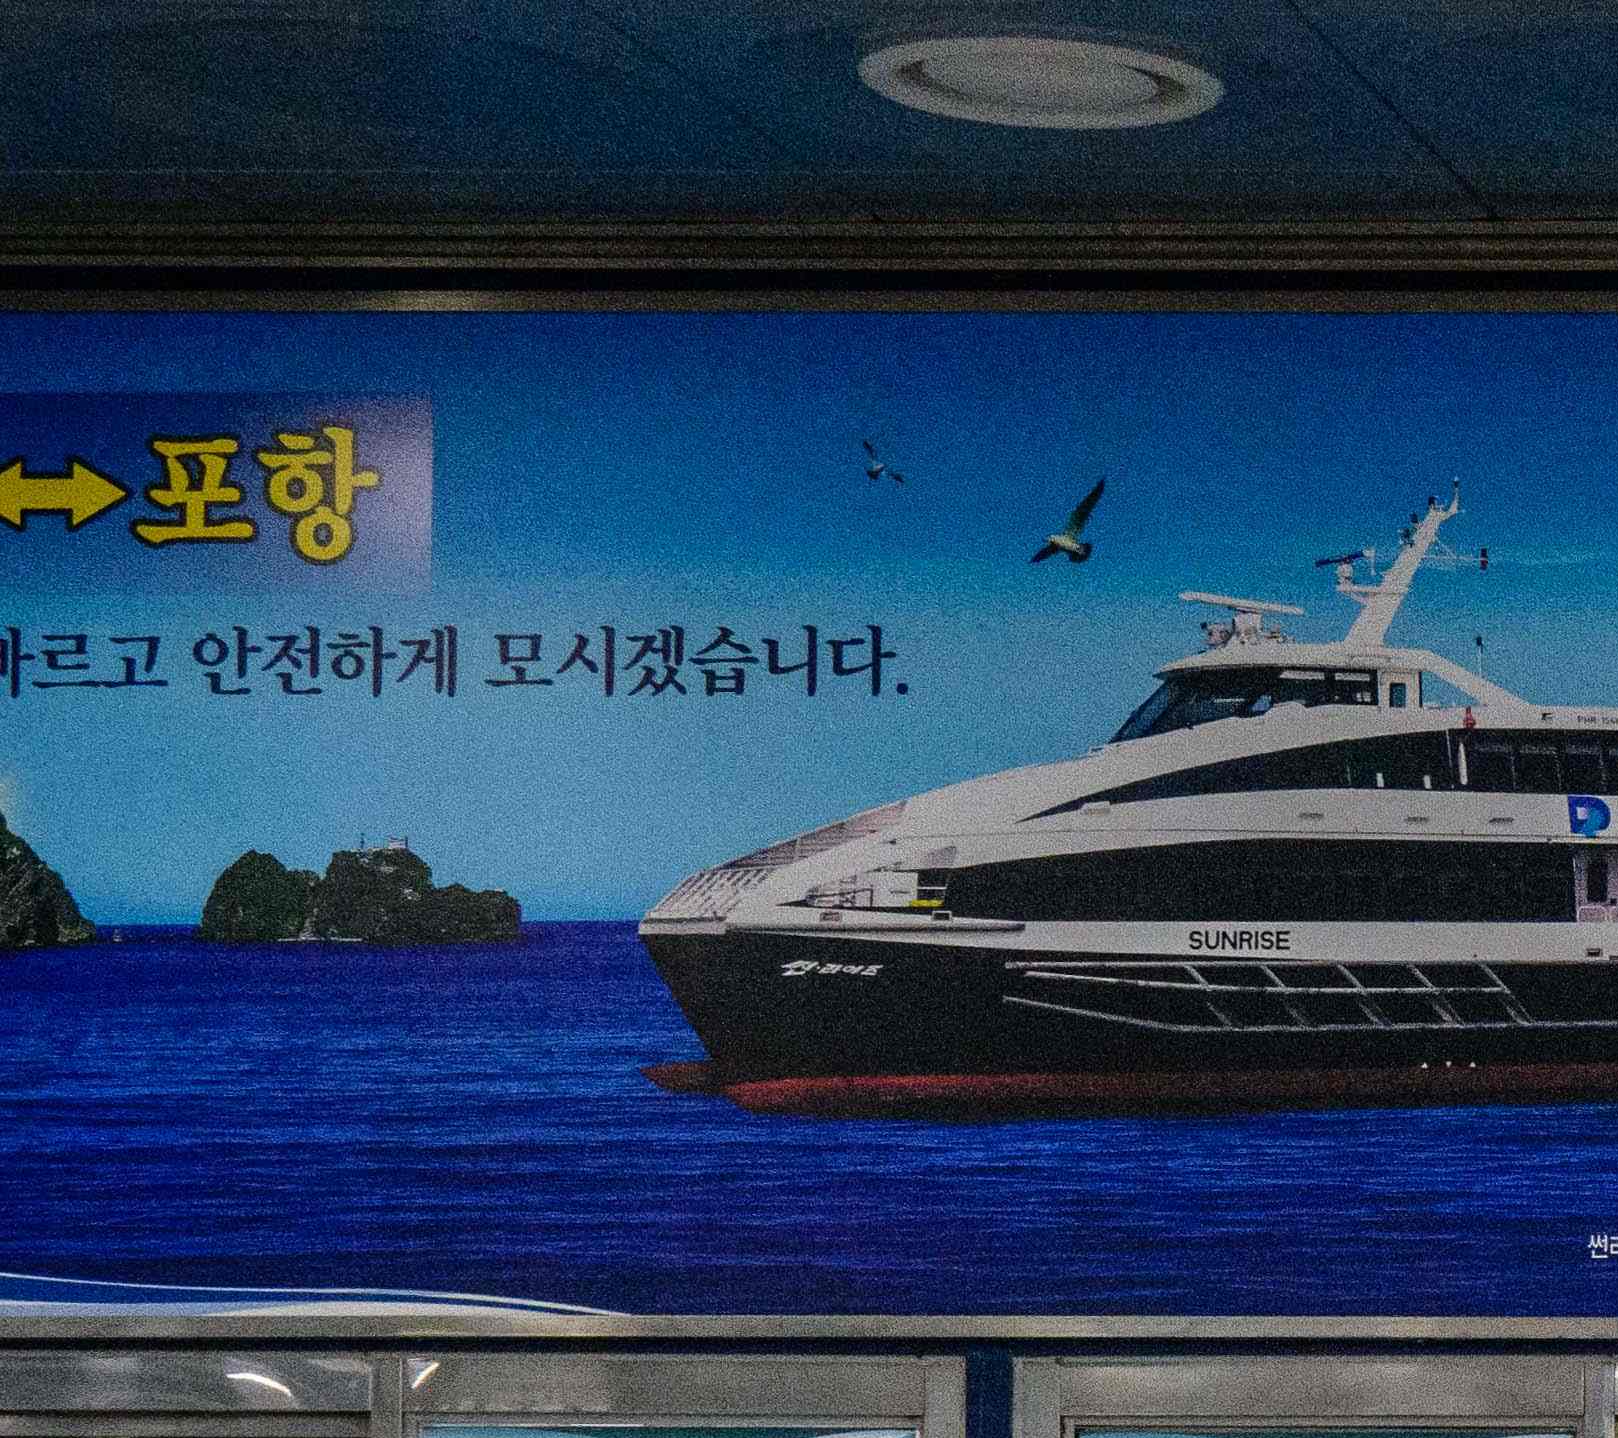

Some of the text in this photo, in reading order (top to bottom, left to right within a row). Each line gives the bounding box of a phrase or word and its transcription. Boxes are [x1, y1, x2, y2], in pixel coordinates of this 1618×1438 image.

[131, 423, 380, 566] 포항
[191, 625, 457, 697] 안전하게
[486, 623, 909, 697] 모시겠습니다.
[1188, 930, 1291, 951] SUNRISE
